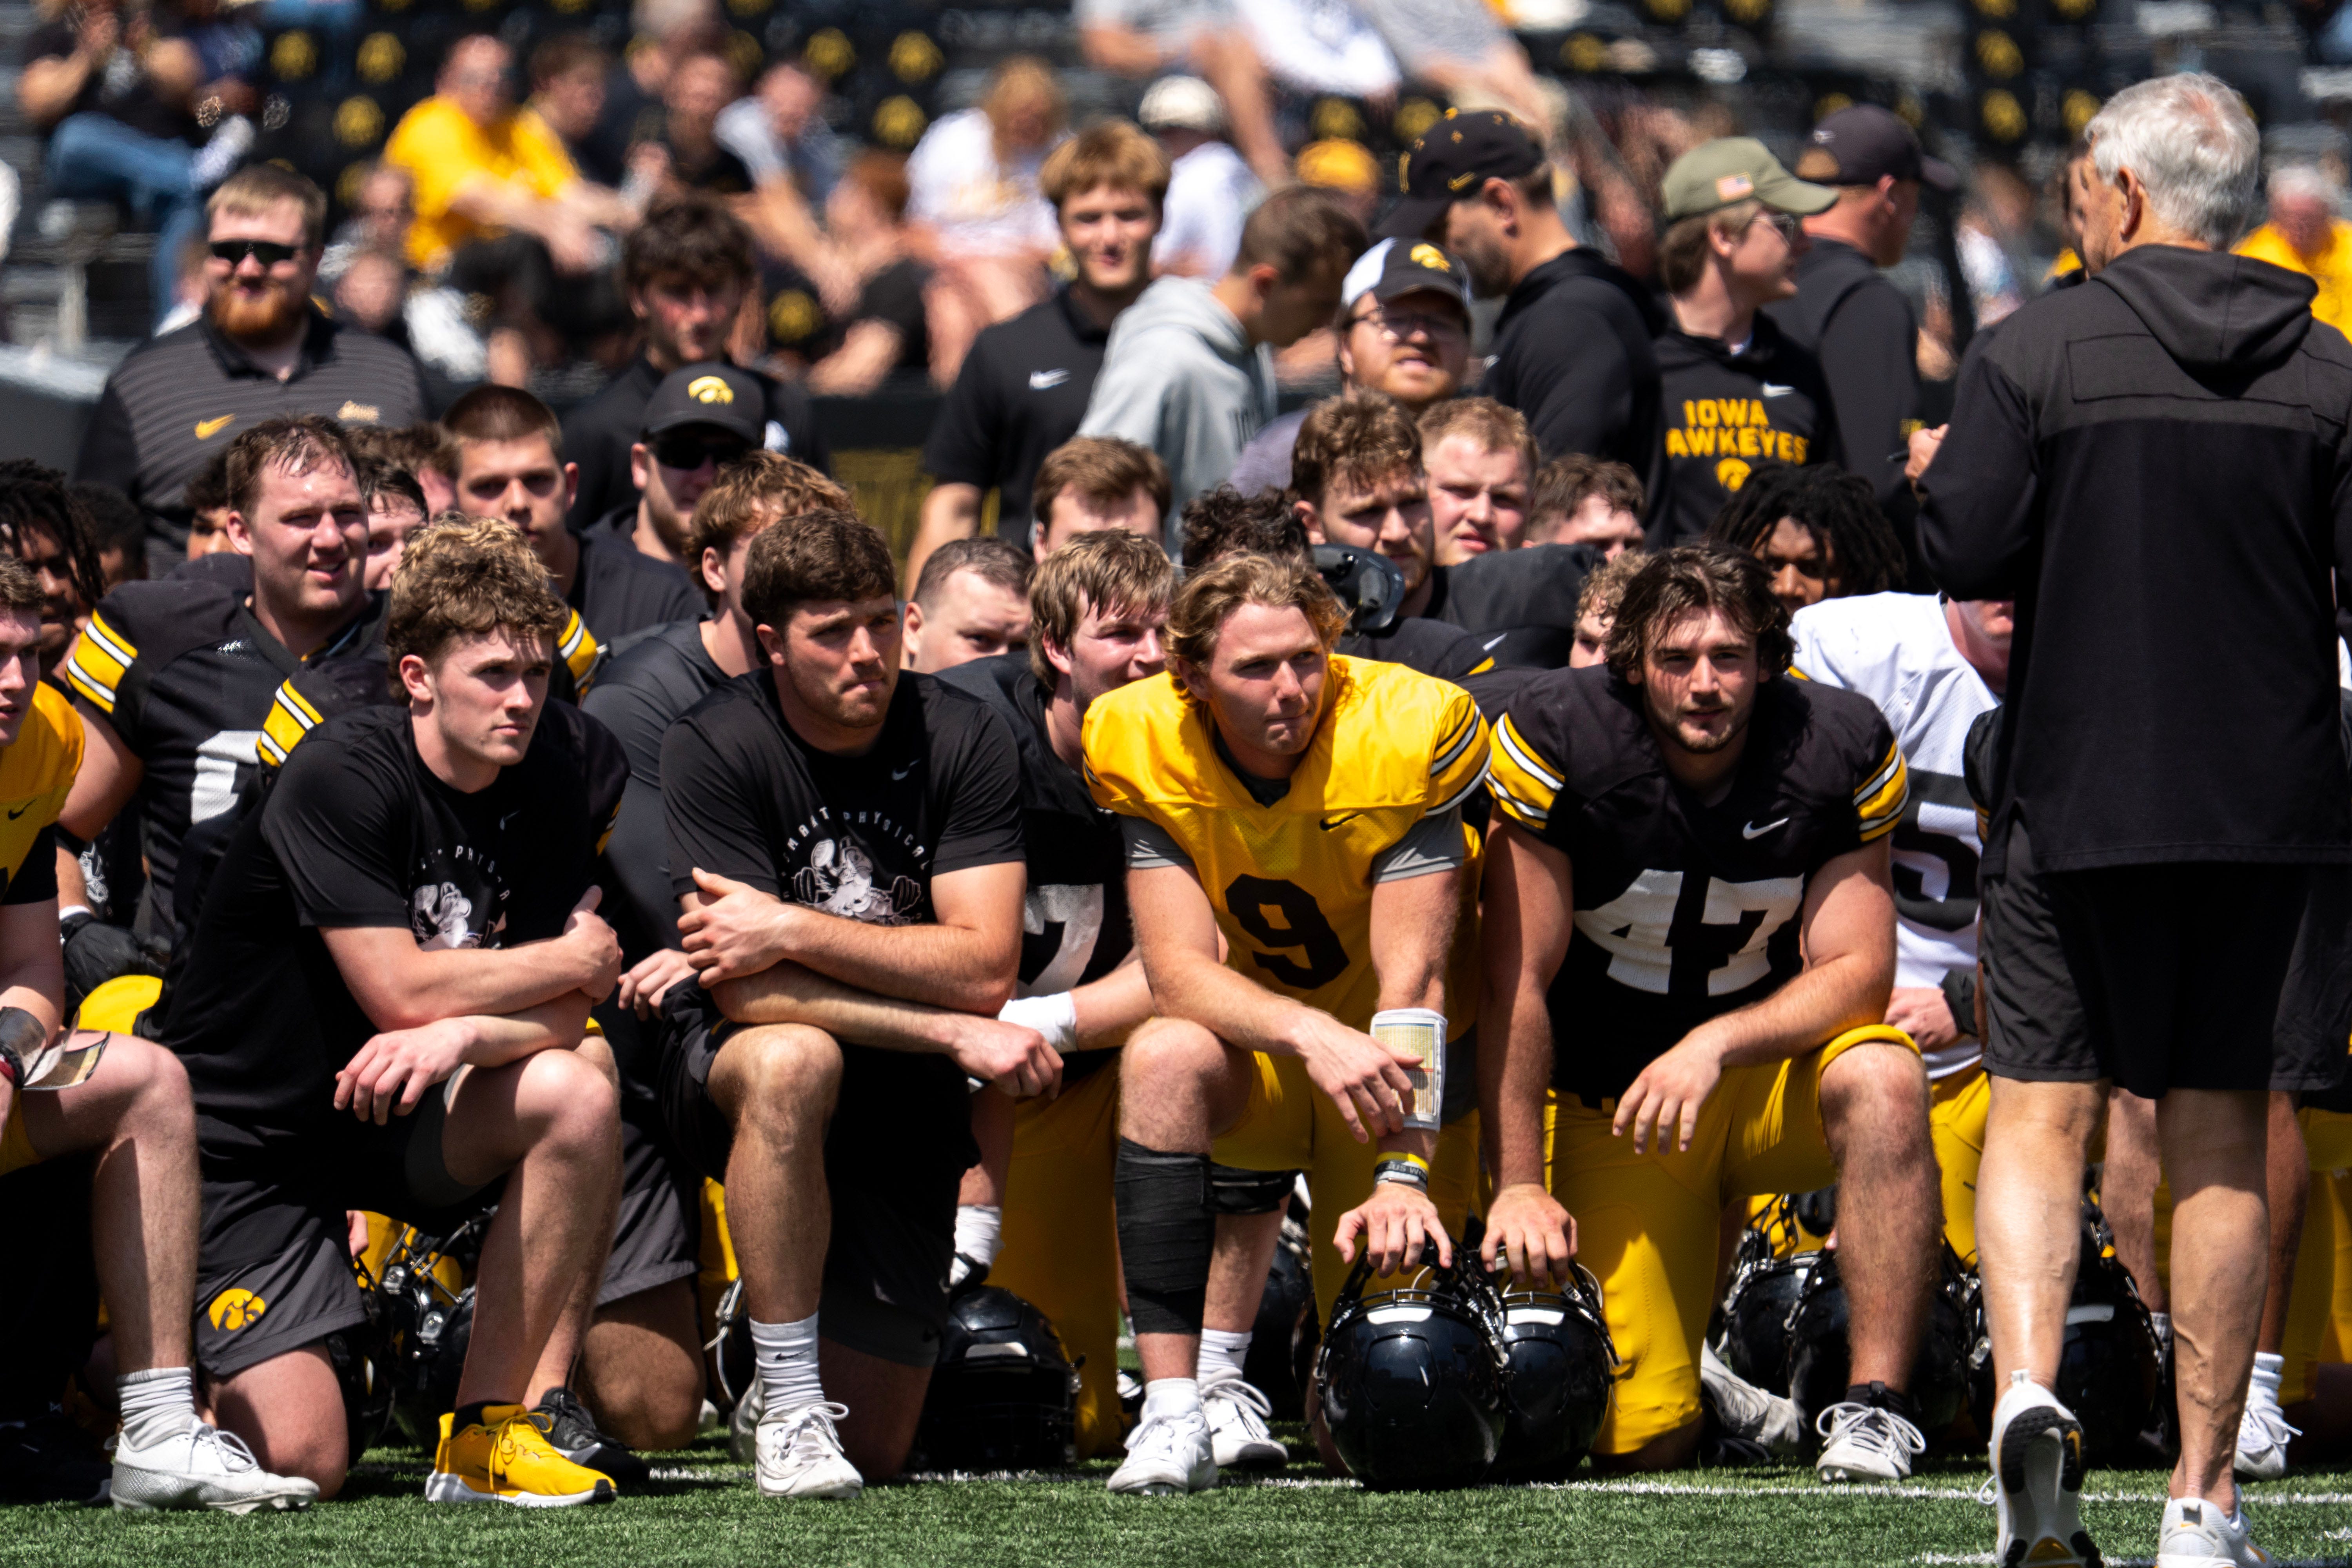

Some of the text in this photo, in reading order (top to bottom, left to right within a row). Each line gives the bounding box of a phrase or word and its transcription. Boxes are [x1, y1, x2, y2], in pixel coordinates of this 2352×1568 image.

[1665, 427, 1809, 465] AWKEYES
[1683, 398, 1769, 428] IOWA
[1225, 873, 1350, 989] 9
[1574, 868, 1804, 996] 47
